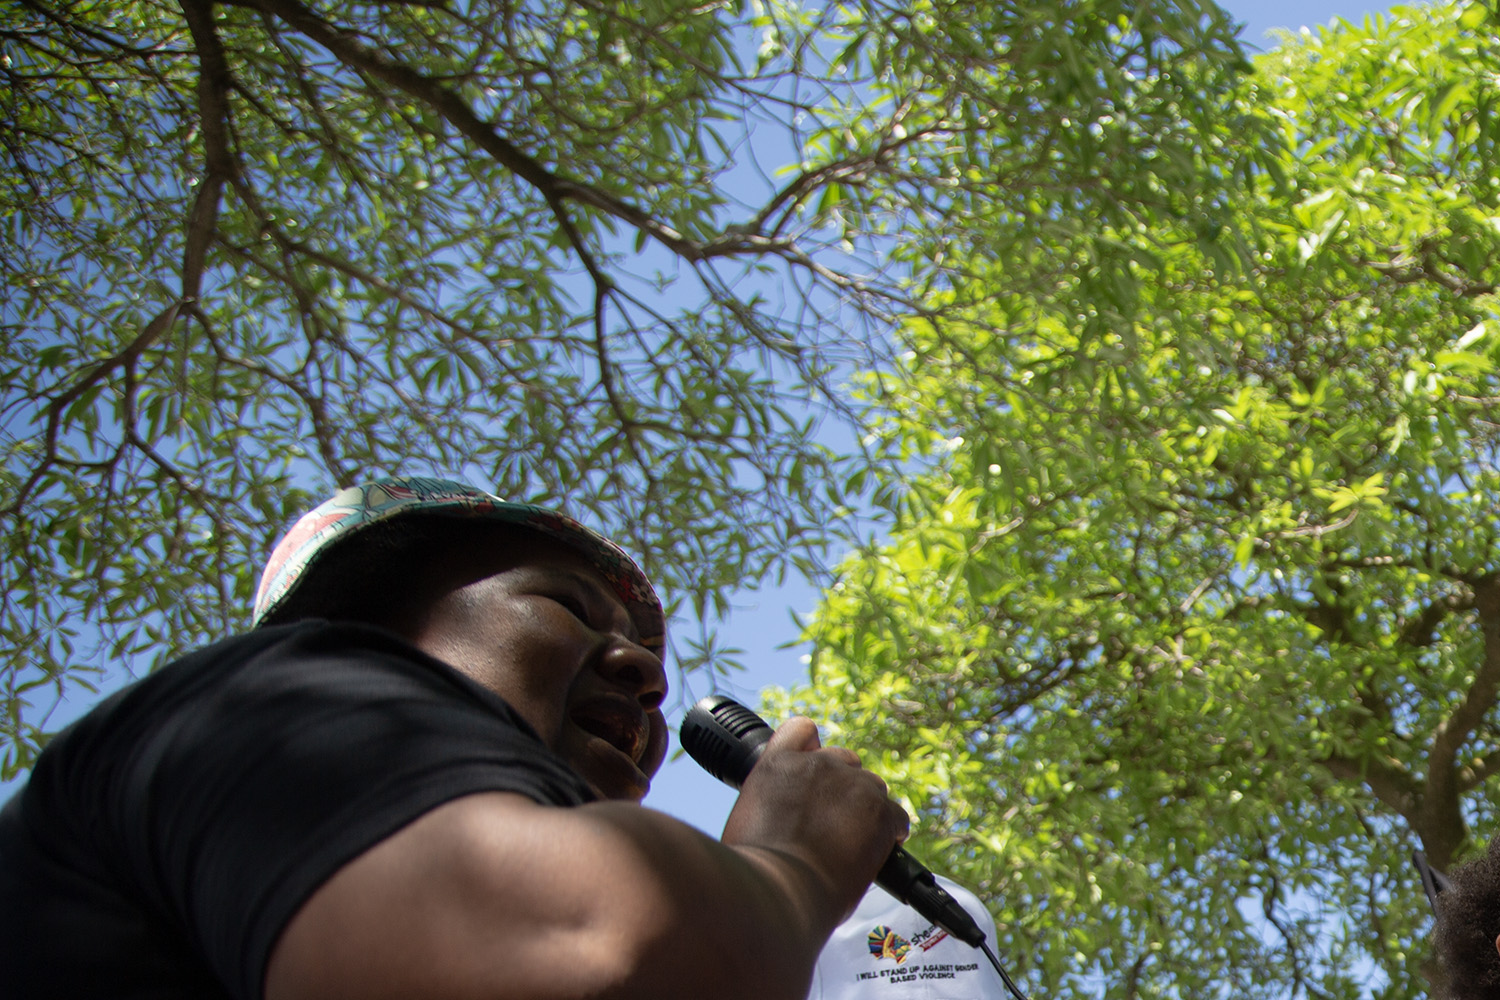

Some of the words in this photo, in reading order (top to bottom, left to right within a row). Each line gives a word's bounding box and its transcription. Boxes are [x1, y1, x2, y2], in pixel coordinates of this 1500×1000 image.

[860, 971, 878, 980] WILL
[880, 967, 908, 977] STAND
[909, 965, 920, 975] UP
[923, 963, 954, 973] AGAINST
[954, 963, 979, 972] GENDER
[890, 974, 917, 984] BASED
[919, 972, 955, 980] VIOLENCE
